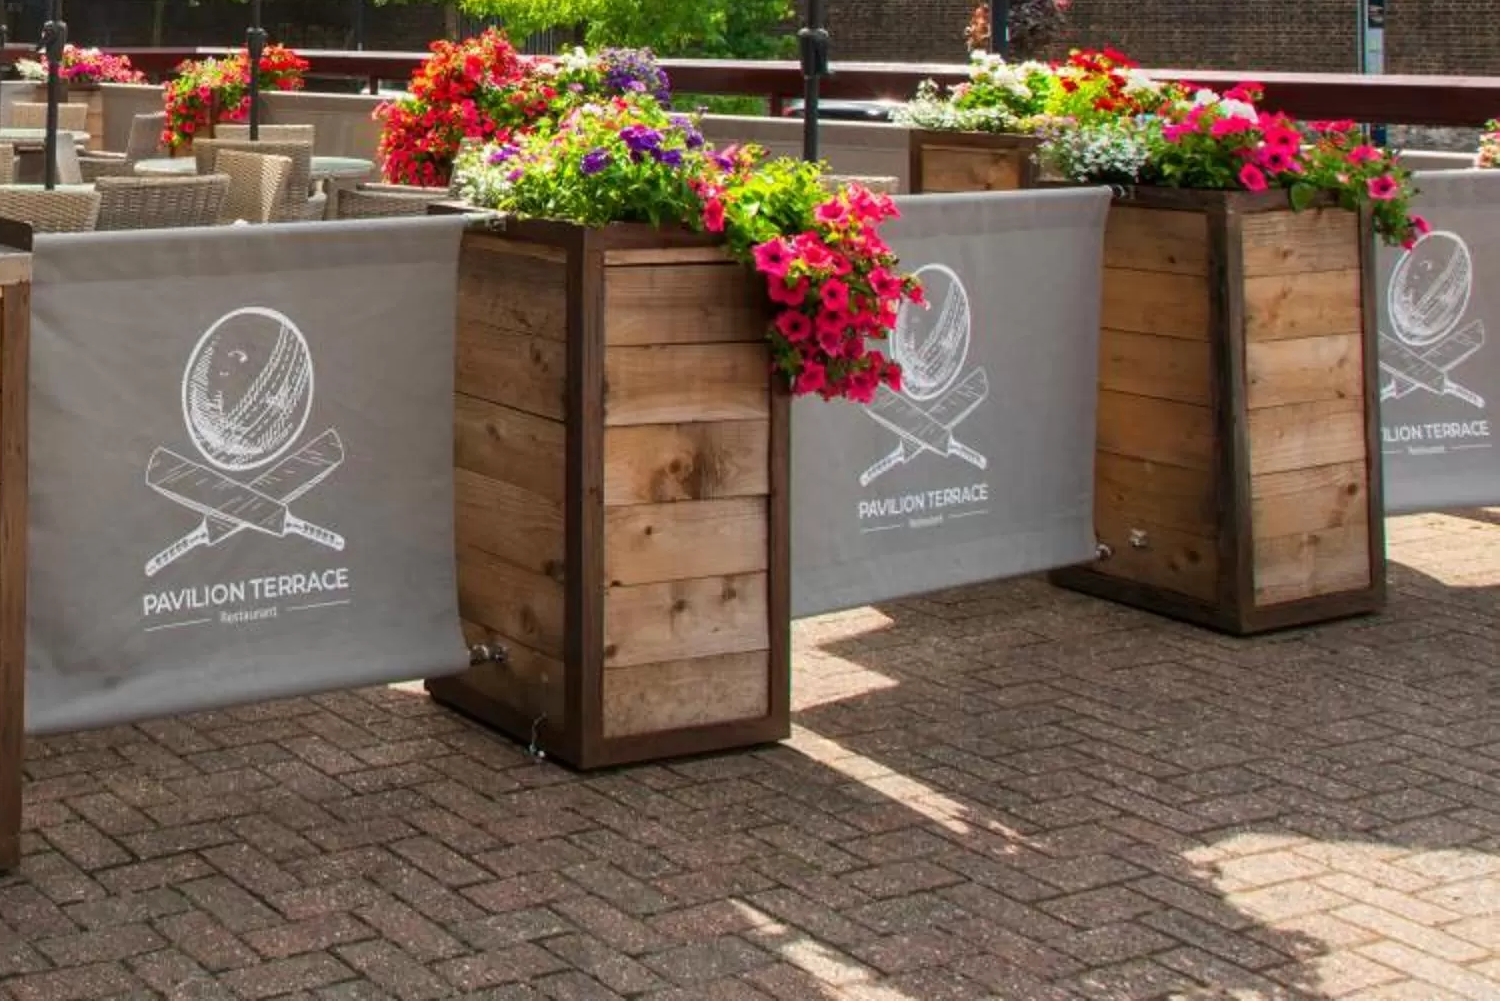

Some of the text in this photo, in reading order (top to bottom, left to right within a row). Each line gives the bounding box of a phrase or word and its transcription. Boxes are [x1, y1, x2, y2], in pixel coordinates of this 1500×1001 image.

[1381, 420, 1490, 442] ILION TERRACE
[858, 483, 989, 519] PAVILION TERRACE
[143, 568, 349, 616] PAVILION TERRACE
